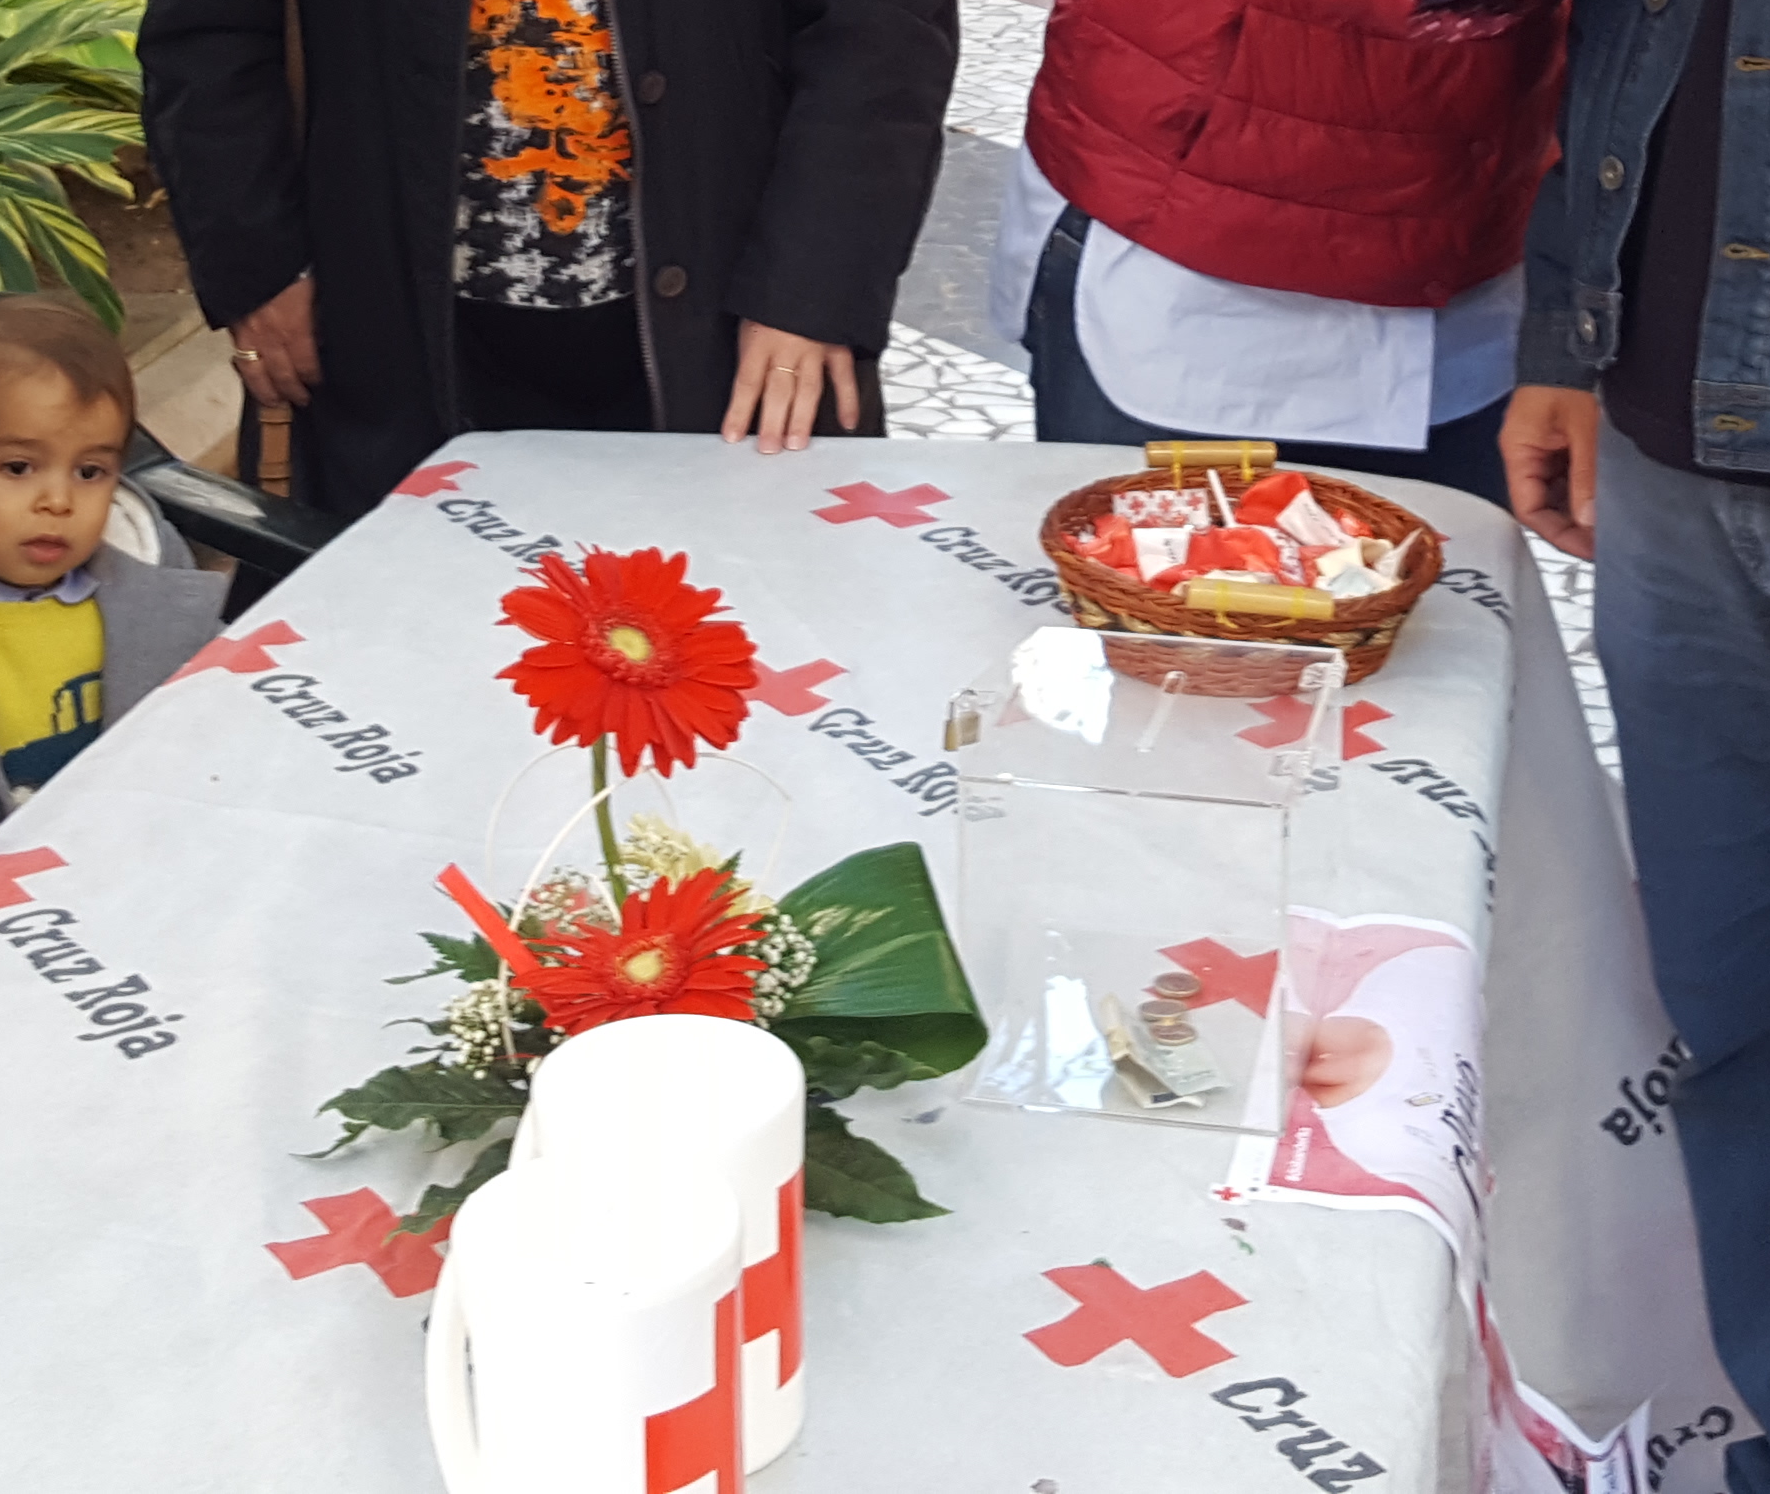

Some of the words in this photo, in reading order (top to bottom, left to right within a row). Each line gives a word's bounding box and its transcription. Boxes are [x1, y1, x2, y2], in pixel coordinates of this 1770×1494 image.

[436, 499, 527, 541] Cruz
[918, 526, 1017, 570] Cruz
[251, 674, 349, 728] Cruz
[318, 723, 423, 784] Roja
[808, 708, 917, 770] Cruz
[63, 973, 185, 1059] Roja
[1210, 1377, 1387, 1494] Cruz
